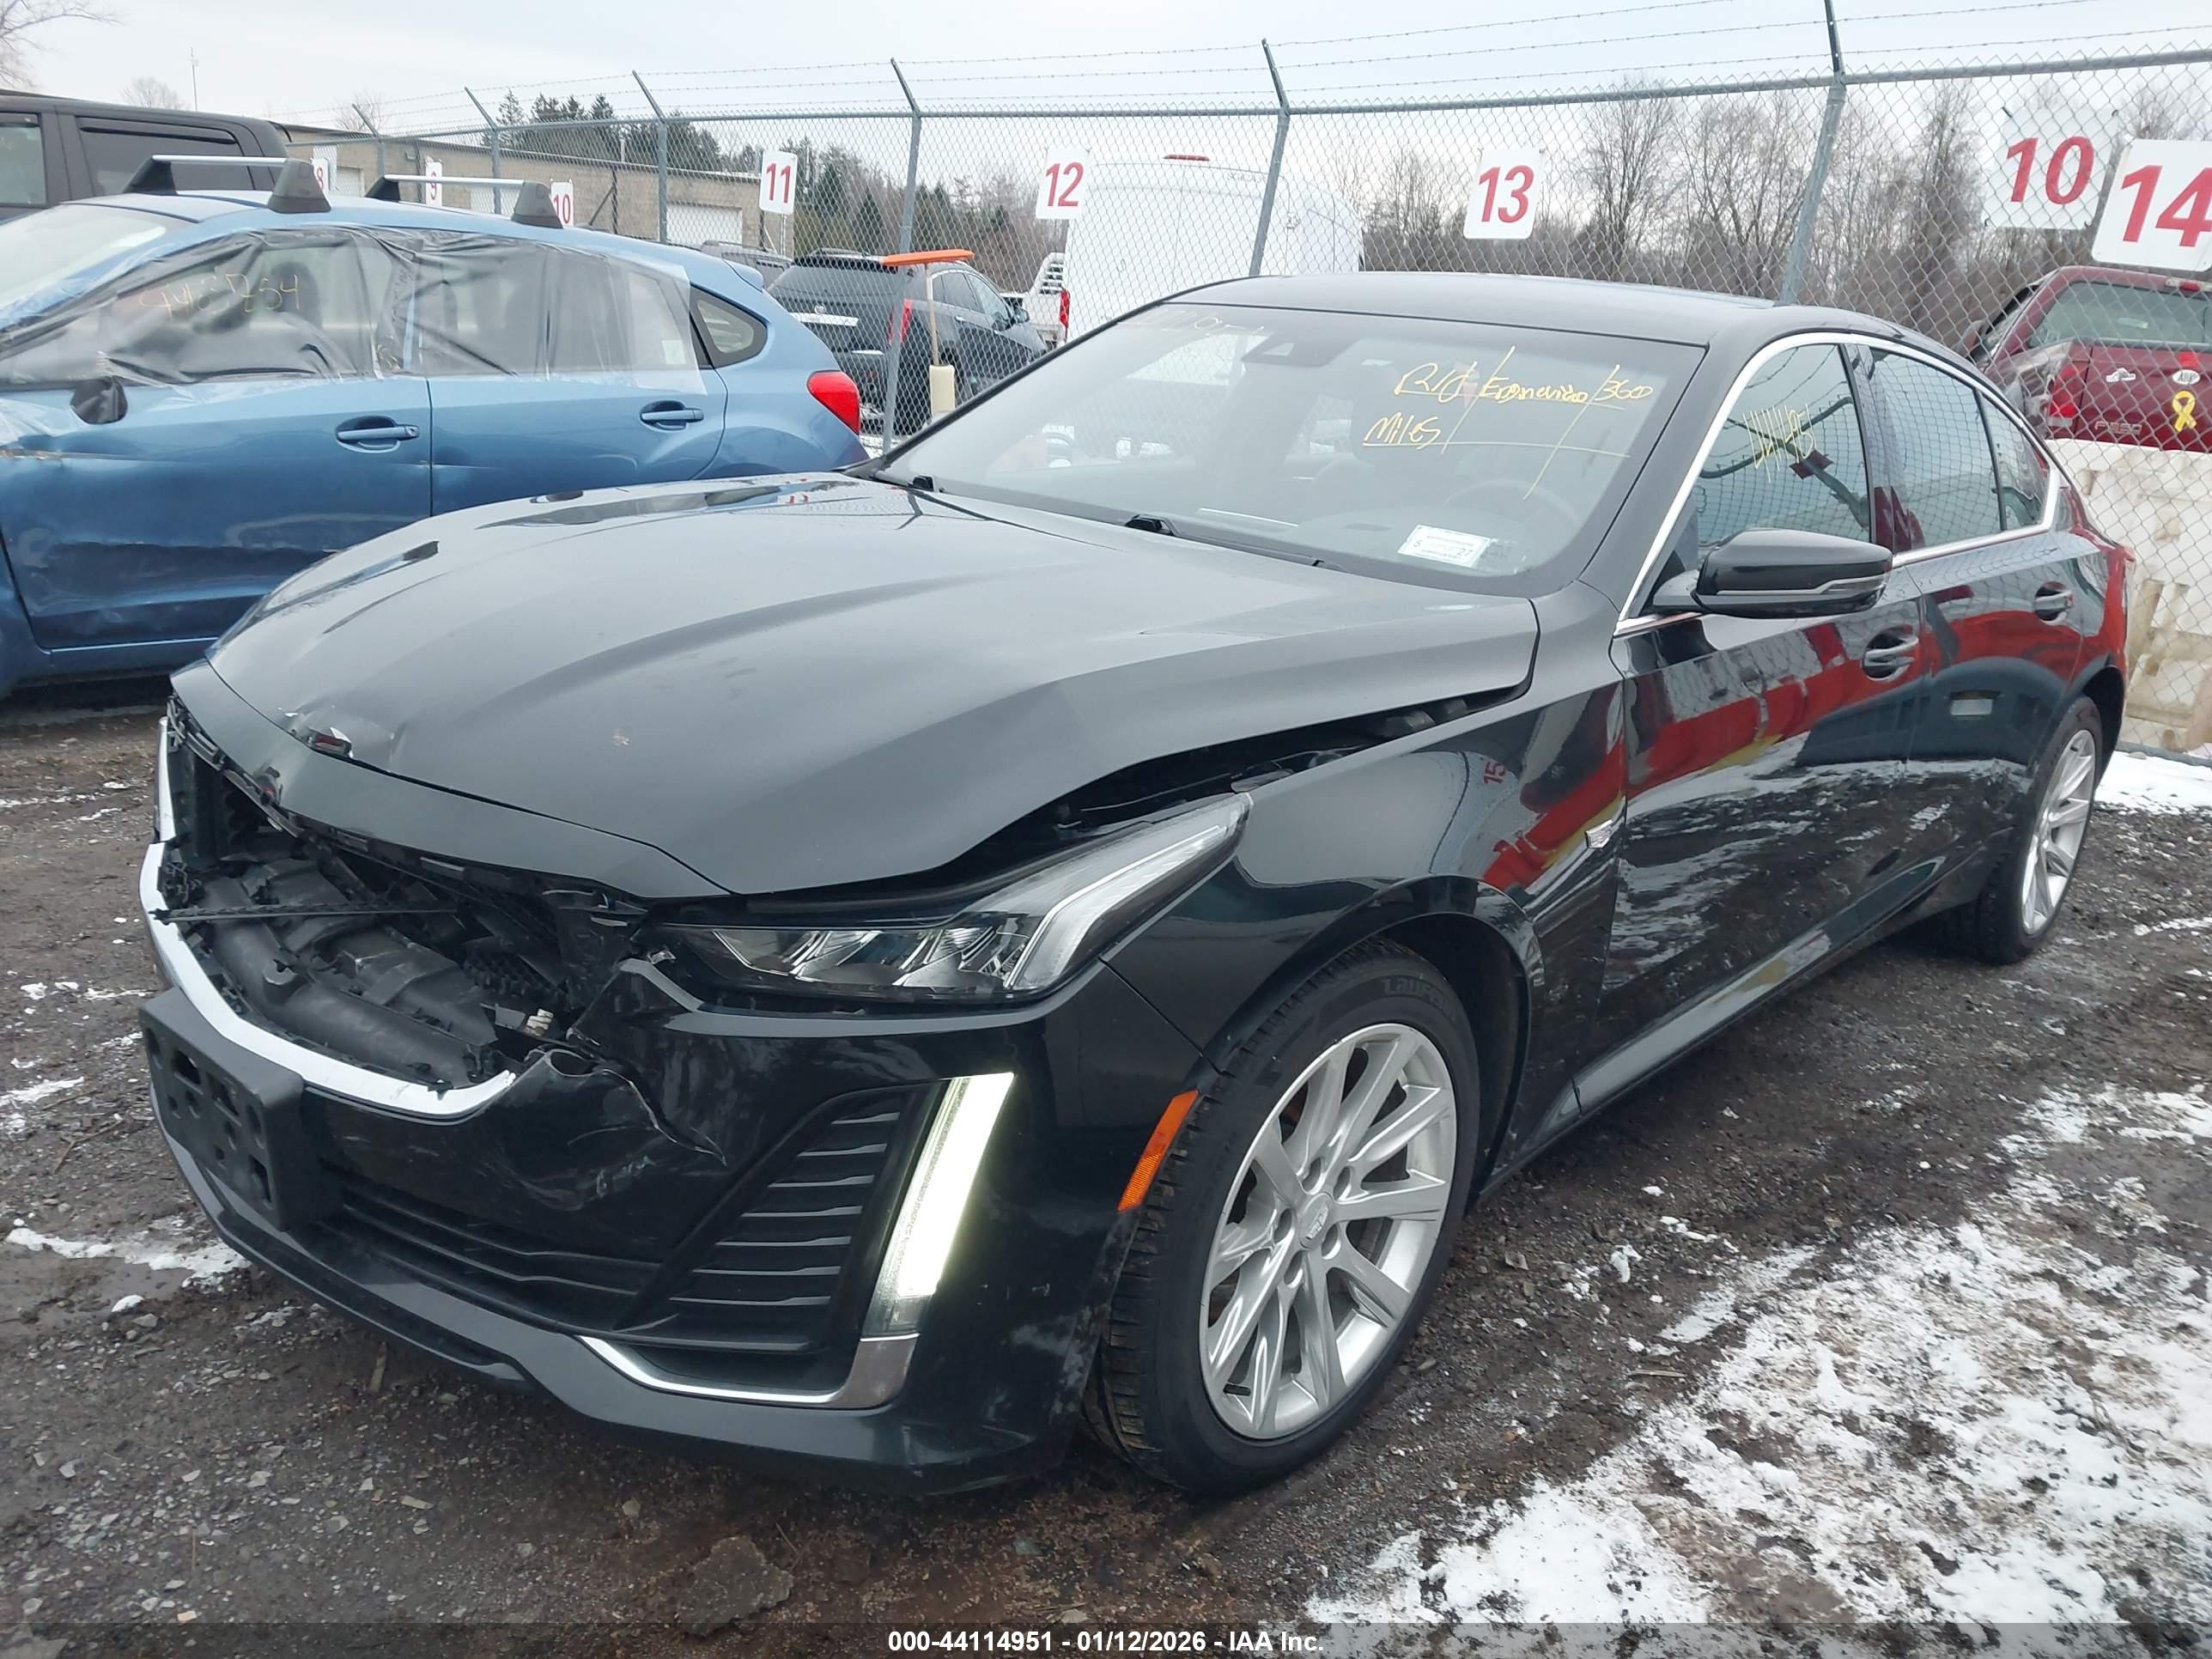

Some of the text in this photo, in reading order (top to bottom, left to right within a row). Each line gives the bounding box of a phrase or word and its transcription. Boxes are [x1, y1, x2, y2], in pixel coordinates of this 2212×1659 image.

[766, 162, 791, 204] 11
[1045, 161, 1084, 207] 12
[1478, 165, 1535, 223] 13
[2006, 136, 2095, 205] 10
[553, 193, 571, 224] 10
[2121, 165, 2212, 247] 14
